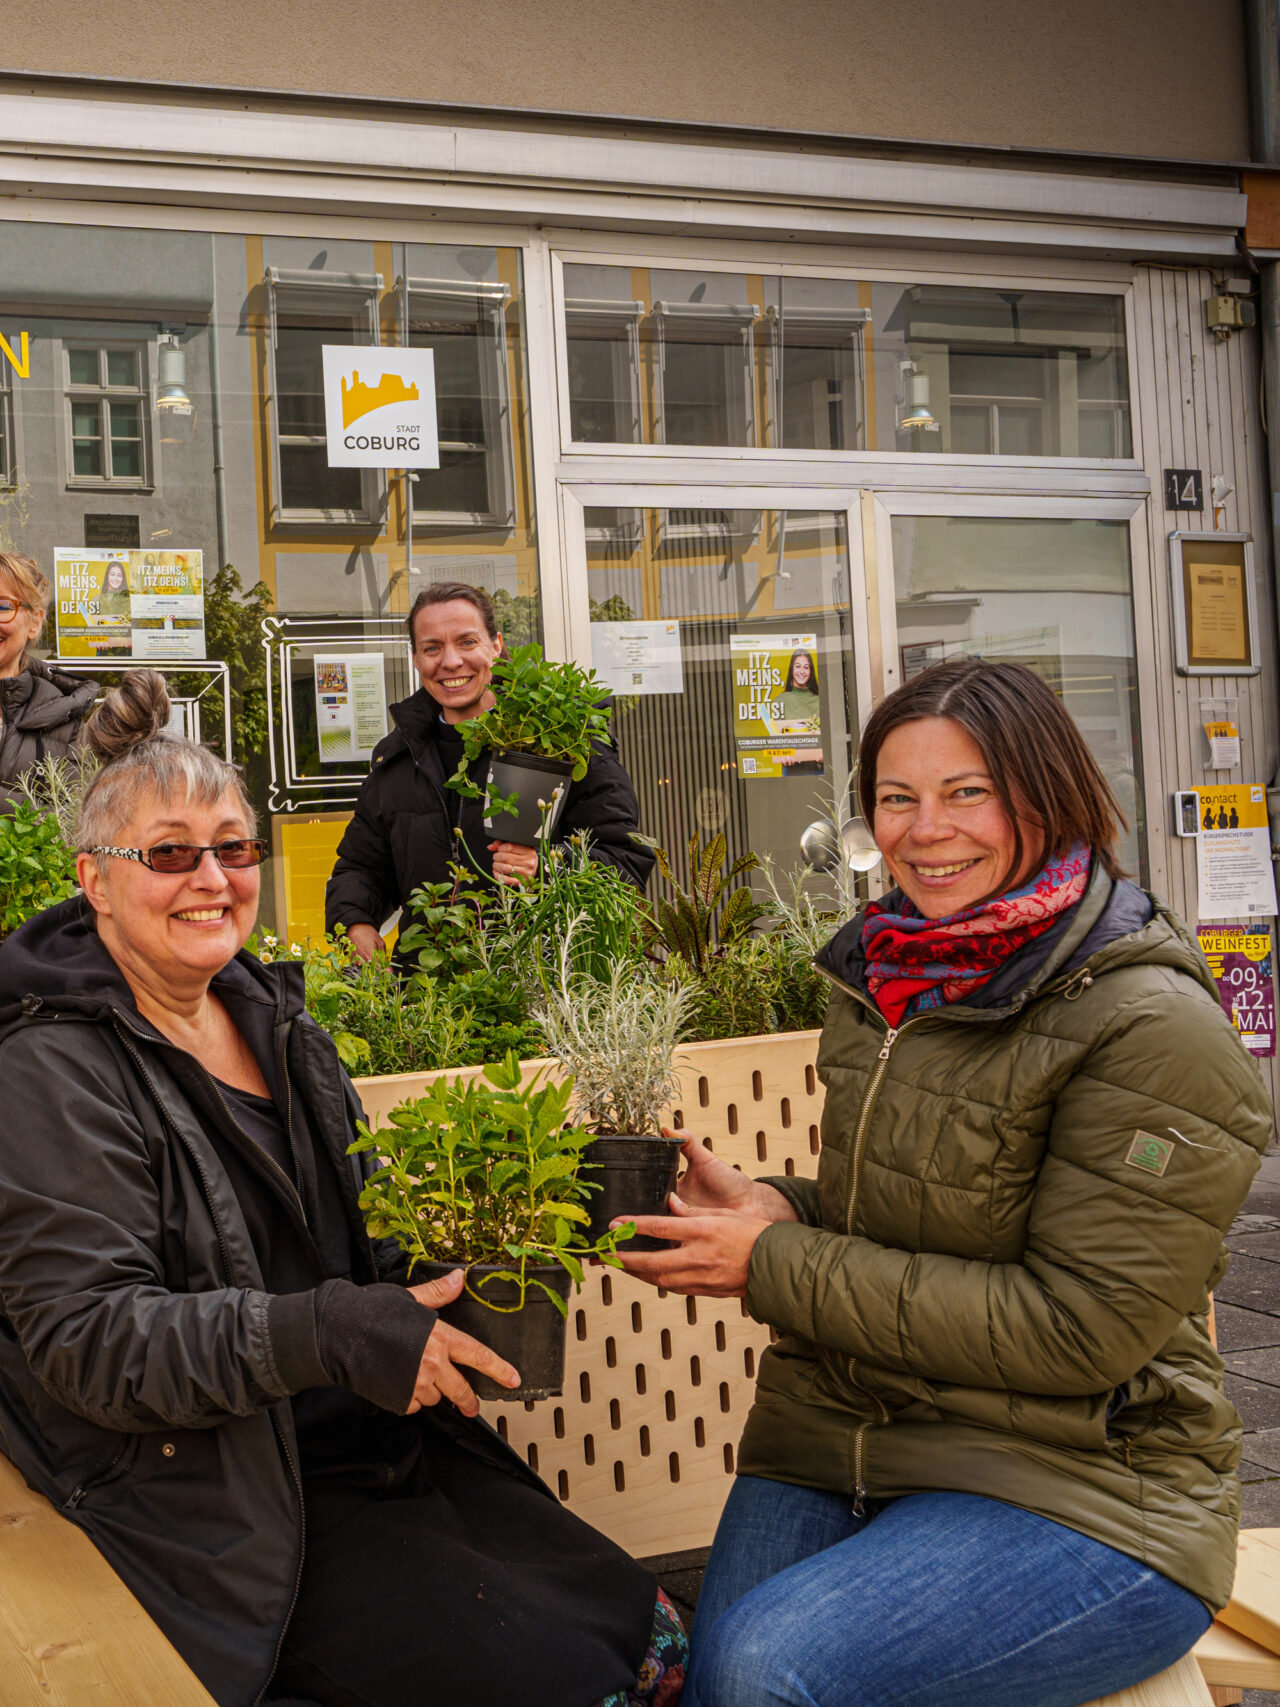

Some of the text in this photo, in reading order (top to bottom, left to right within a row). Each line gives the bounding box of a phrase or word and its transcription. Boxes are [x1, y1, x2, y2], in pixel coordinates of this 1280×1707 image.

[396, 425, 422, 433] STADT
[343, 435, 421, 451] COBURG
[1171, 474, 1198, 506] 14
[70, 562, 89, 576] ITZ
[137, 565, 185, 577] ITZ MEINS,
[59, 575, 100, 591] MEINS,
[144, 576, 158, 587] ITZ
[71, 588, 89, 602] ITZ
[748, 652, 771, 669] ITZ
[736, 668, 785, 688] MEINS,
[750, 686, 772, 702] ITZ
[1200, 929, 1243, 938] COBURGER
[1201, 937, 1268, 950] WEINFEST
[1230, 967, 1264, 992] 09.
[1237, 990, 1274, 1010] 12.
[1238, 1011, 1274, 1031] MAI
